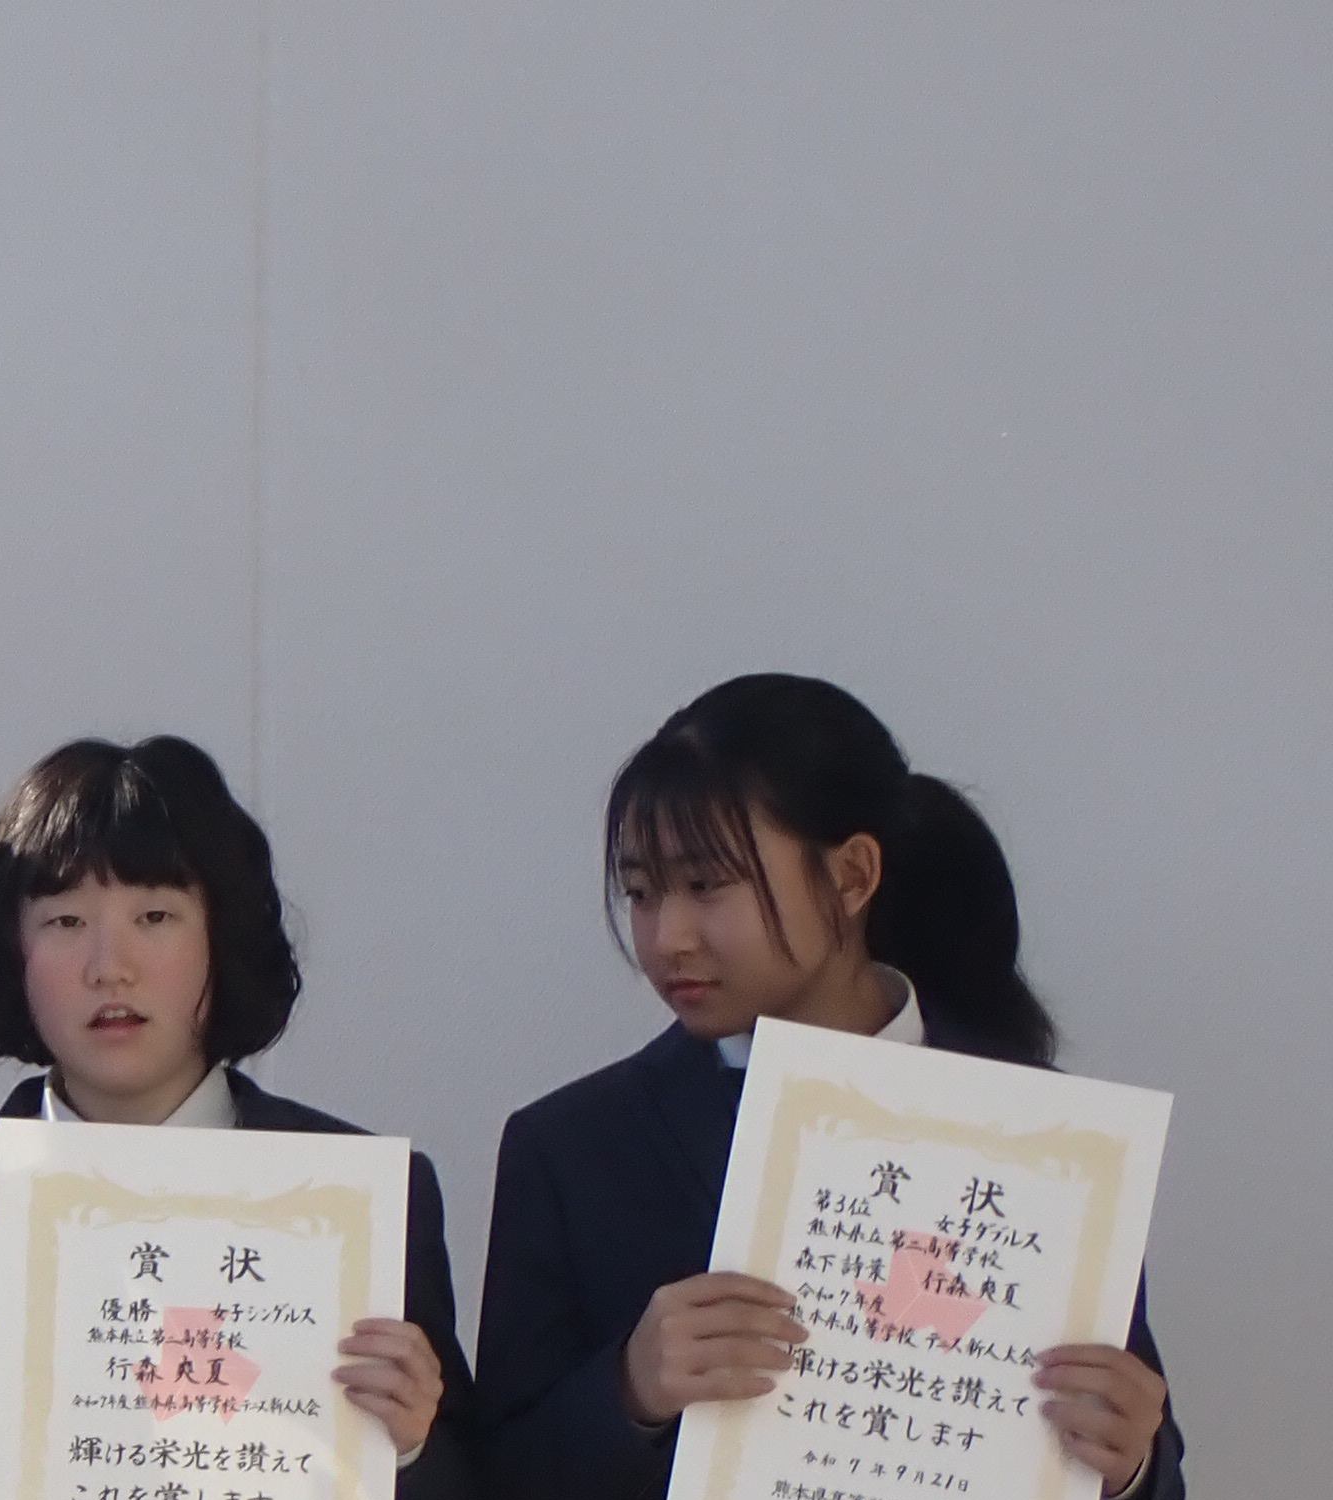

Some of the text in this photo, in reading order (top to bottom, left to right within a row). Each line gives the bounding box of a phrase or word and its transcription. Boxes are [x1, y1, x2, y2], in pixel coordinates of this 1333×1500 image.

[870, 1160, 1005, 1218] 賞状
[814, 1187, 1042, 1254] 第3位 女子ダブルス
[130, 1241, 266, 1283] 賞状
[100, 1297, 317, 1325] 優勝 女子シングルス
[777, 1393, 984, 1451] これを賞します
[69, 1434, 314, 1474] 輝ける栄光を讃えて
